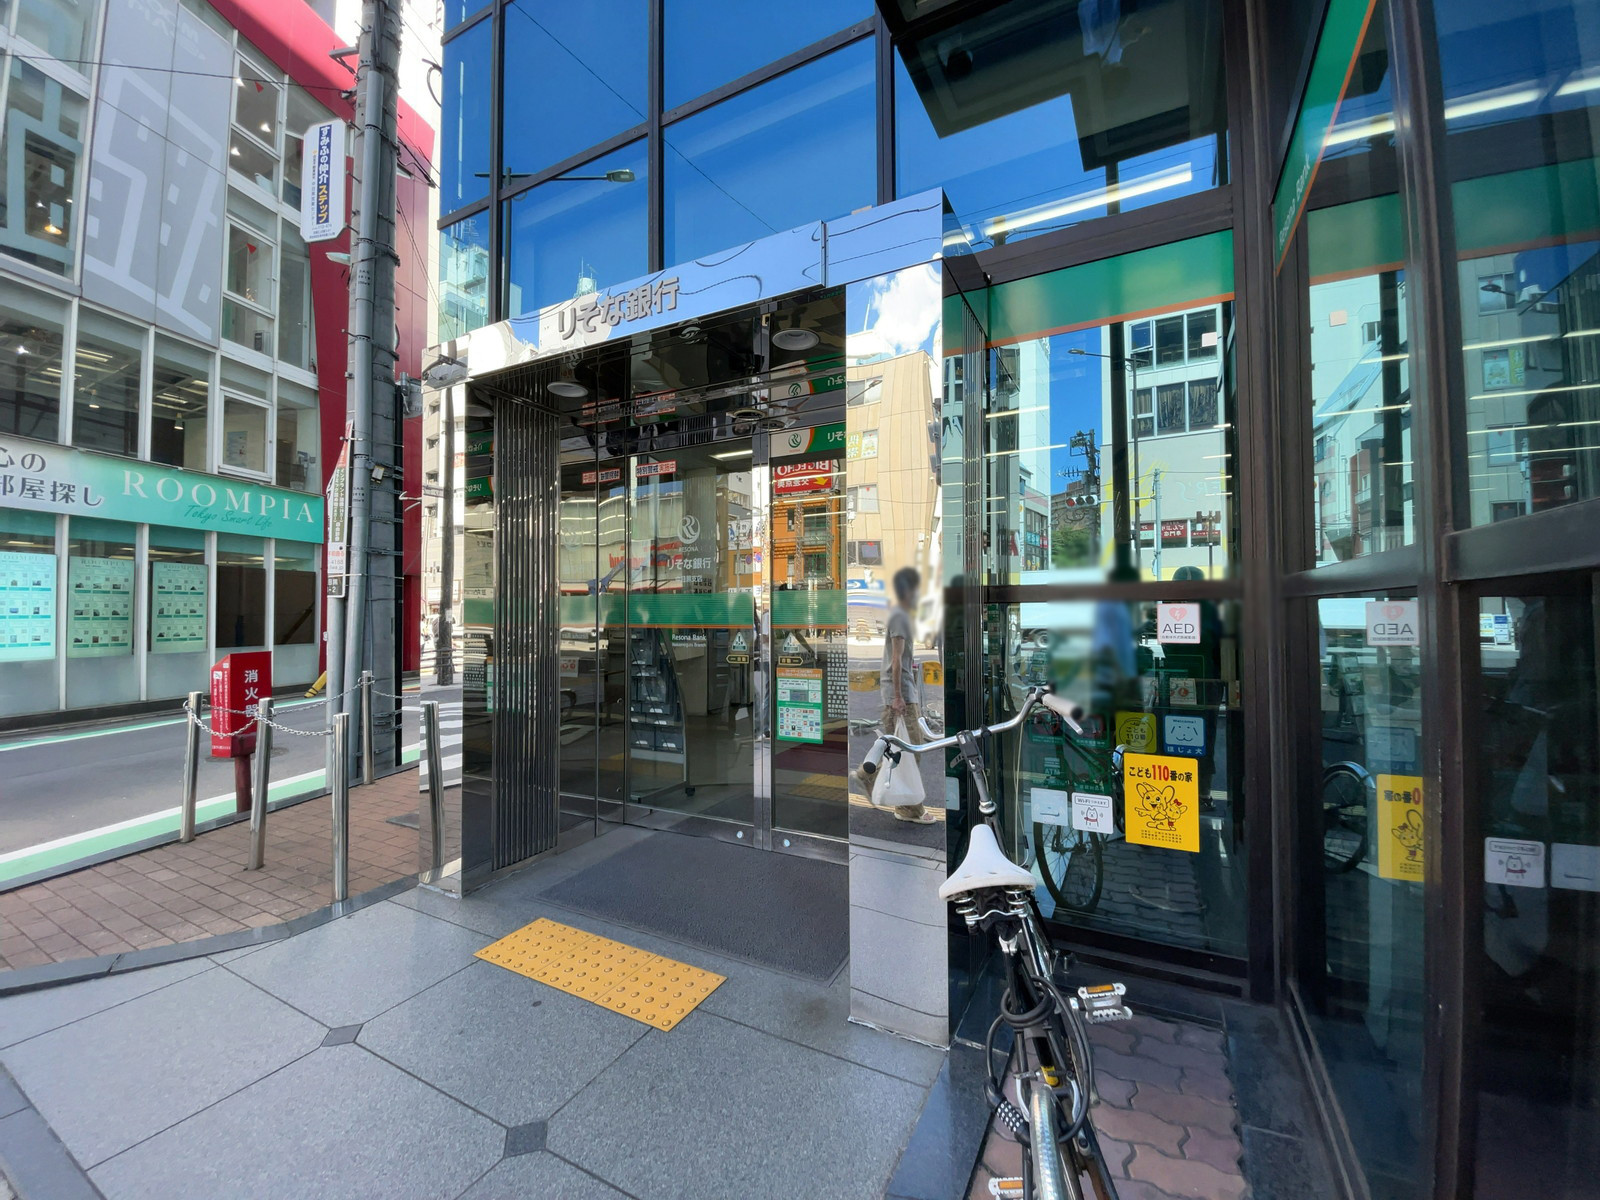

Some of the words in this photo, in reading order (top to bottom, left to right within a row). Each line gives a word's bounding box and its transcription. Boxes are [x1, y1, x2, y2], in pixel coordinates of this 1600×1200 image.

[557, 277, 679, 341] りそな銀行
[121, 469, 315, 523] ROOMPIA
[184, 504, 218, 526] Tokyo
[221, 511, 252, 526] Smart
[667, 557, 711, 570] りそな銀行
[672, 633, 691, 641] Resona
[692, 633, 707, 641] Bank
[1162, 624, 1194, 634] AED
[1128, 764, 1193, 783] こども110番の家
